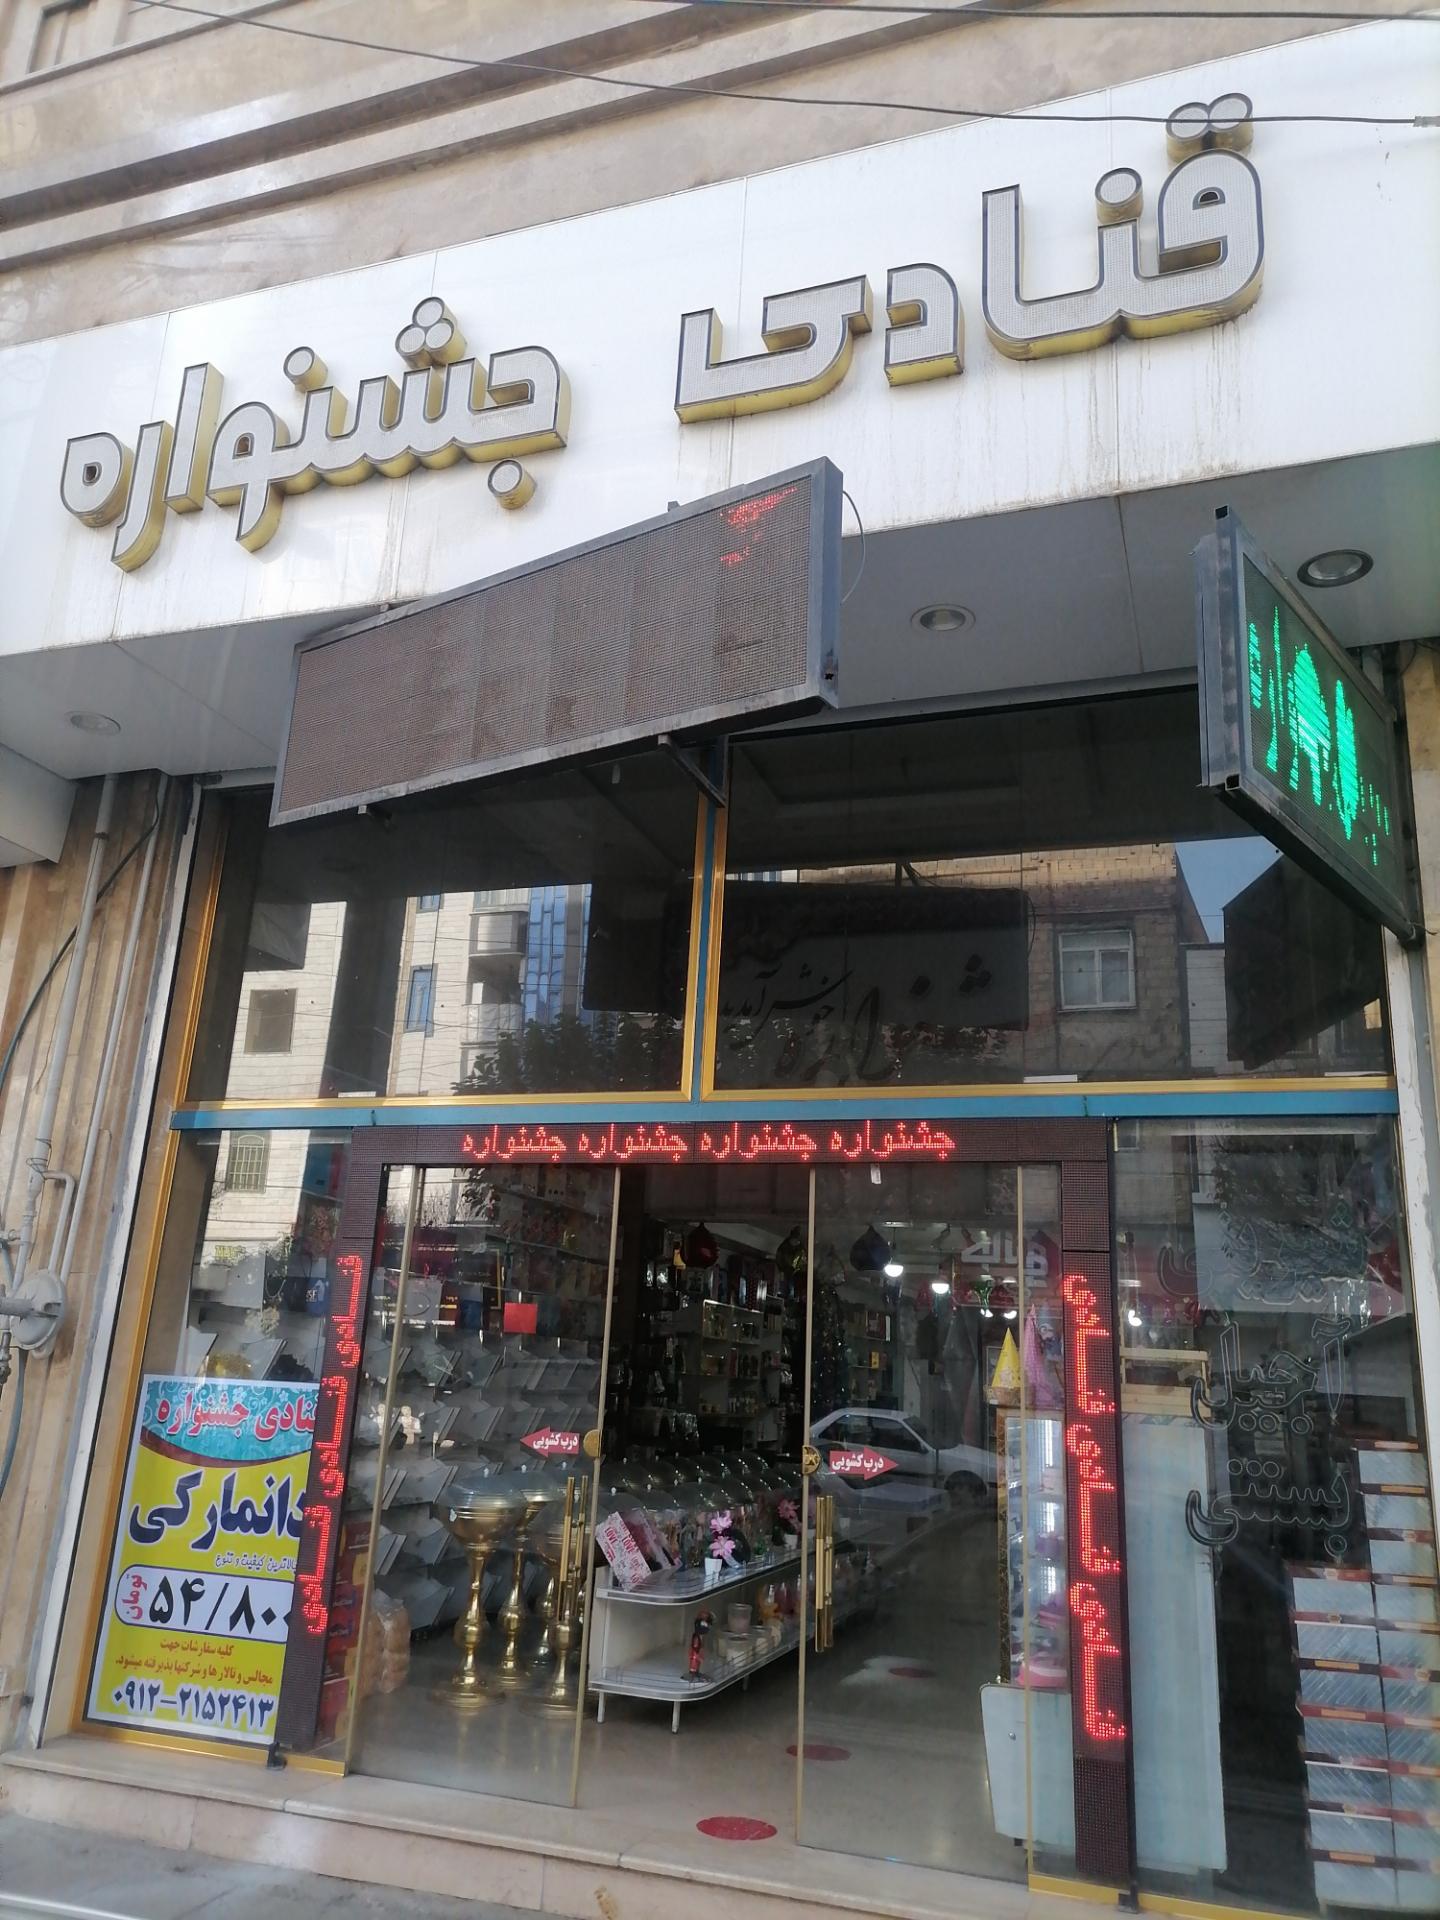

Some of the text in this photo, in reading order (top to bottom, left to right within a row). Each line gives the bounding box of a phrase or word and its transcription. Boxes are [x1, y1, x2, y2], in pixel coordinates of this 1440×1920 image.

[60, 92, 1265, 572] قنادی جشنواره
[462, 1119, 956, 1162] جشنواره جشنواره جشنواره جشنواره
[1190, 1317, 1351, 1432] آجیل
[156, 1390, 317, 1441] نادی جشنواره
[297, 1255, 363, 1635] قنادی قنادی قنادی
[532, 1432, 579, 1450] درب کشویی
[831, 1453, 884, 1472] درب کشویی
[129, 1469, 306, 1550] دانمارکی
[1062, 1274, 1127, 1739] قنادی قنادی قنادی
[1185, 1458, 1351, 1558] بستنی
[216, 1552, 234, 1568] تنوع
[241, 1554, 266, 1571] کیفیت
[122, 1573, 147, 1620] تومان
[160, 1638, 234, 1659] کلیه سفارشات جهت
[243, 1669, 273, 1686] مجالس
